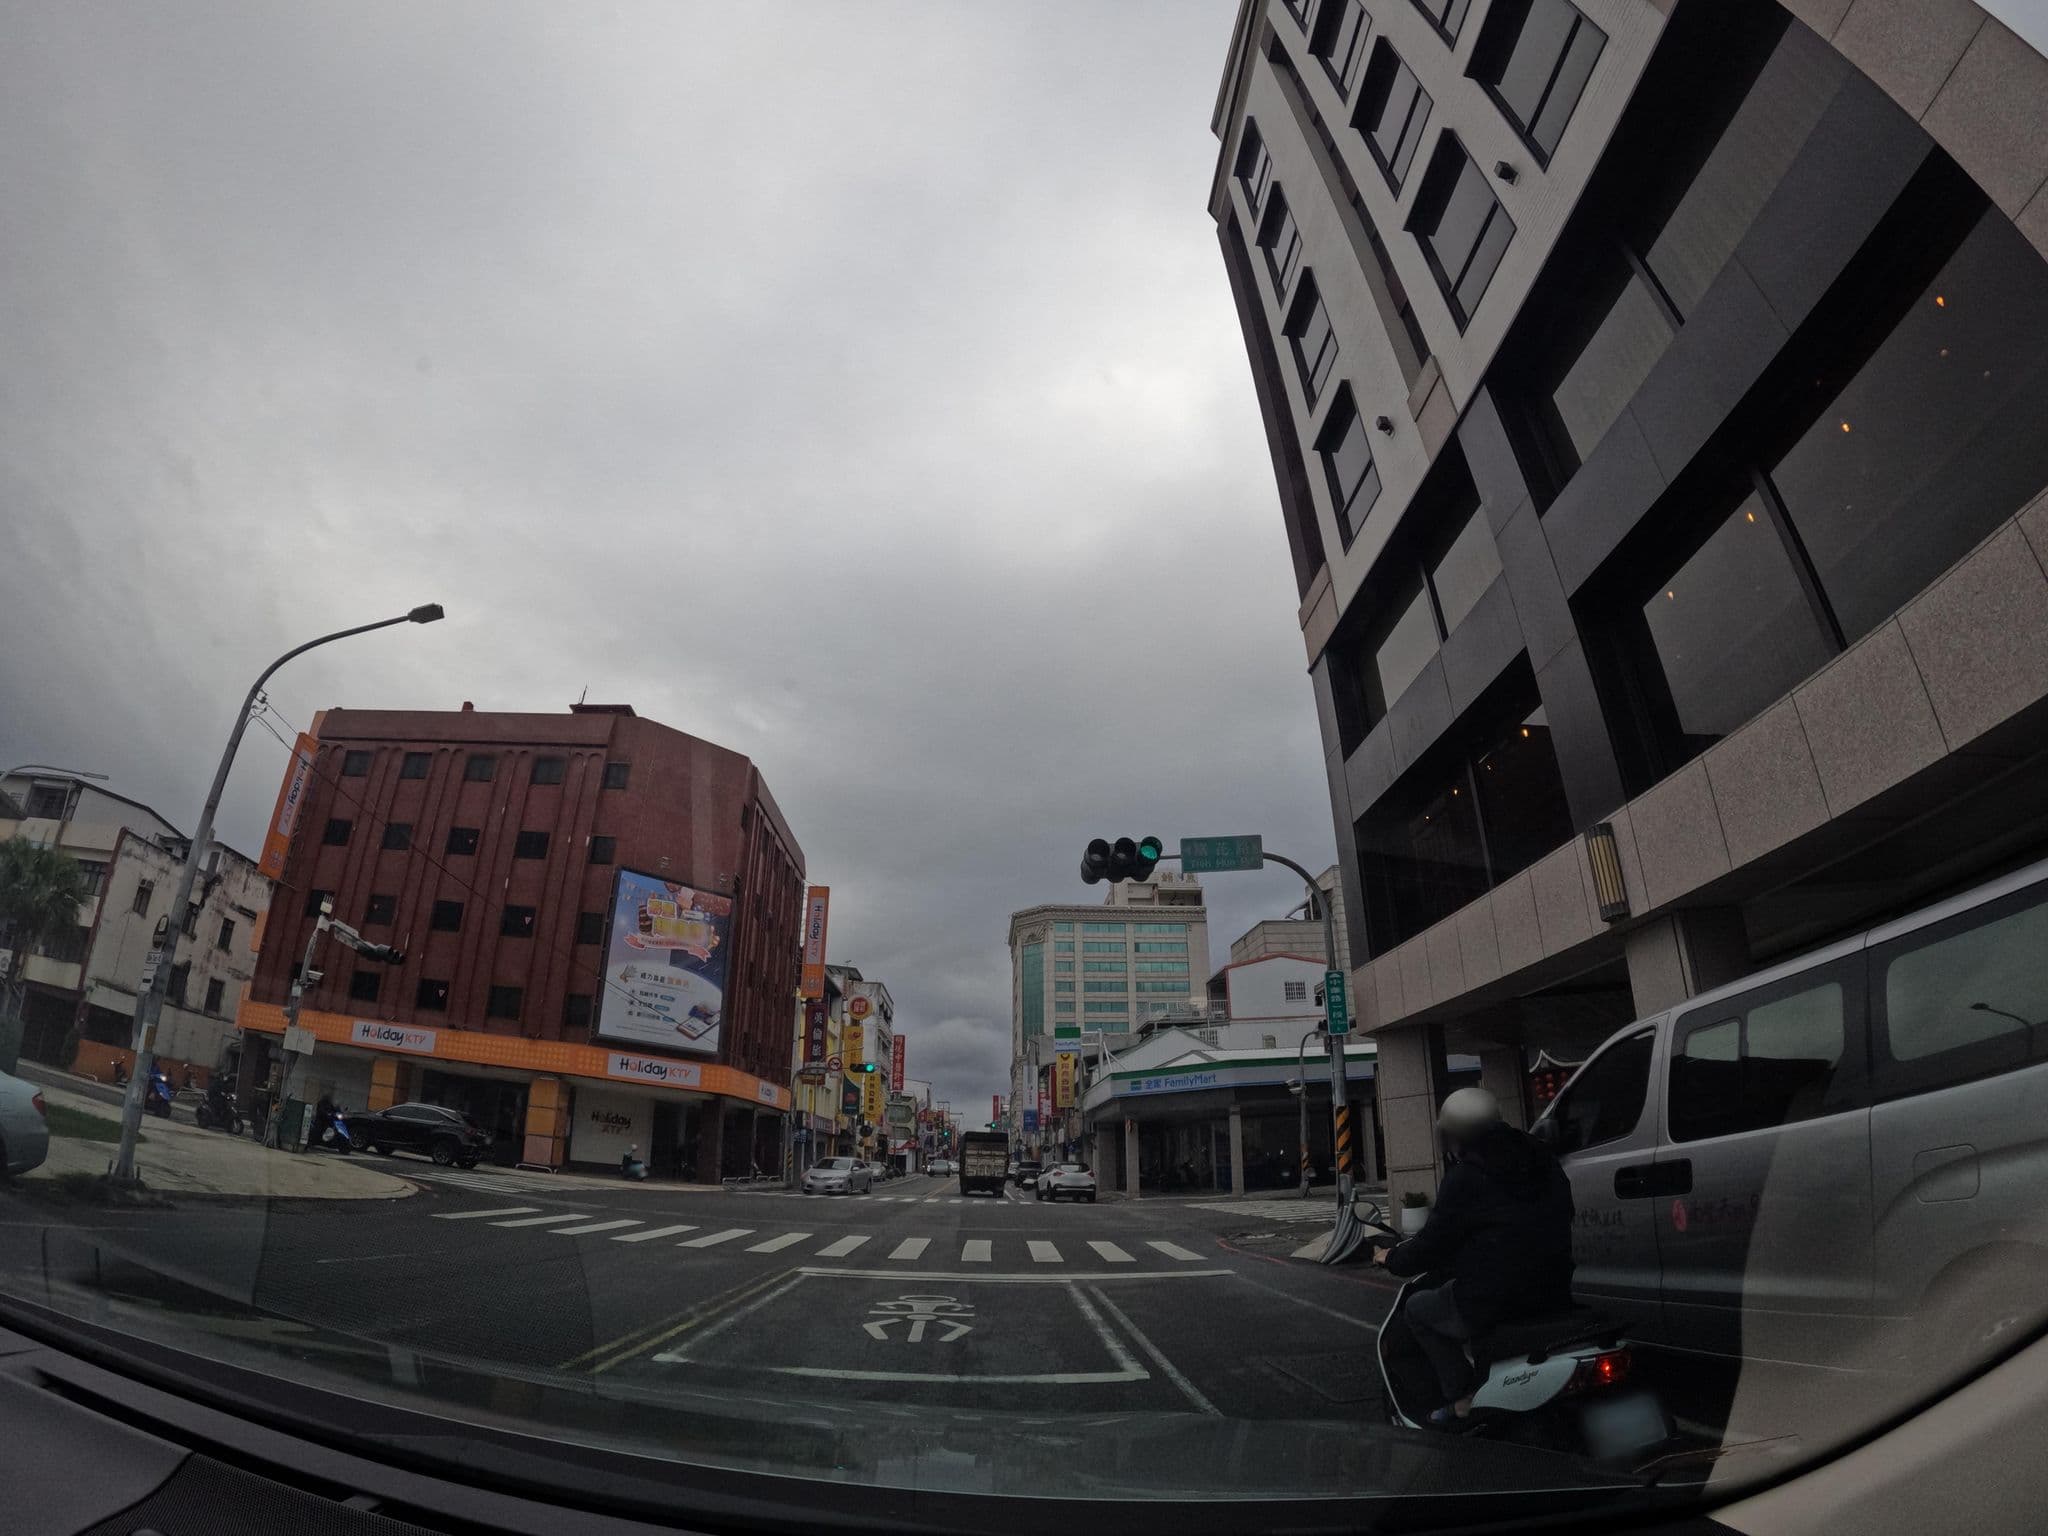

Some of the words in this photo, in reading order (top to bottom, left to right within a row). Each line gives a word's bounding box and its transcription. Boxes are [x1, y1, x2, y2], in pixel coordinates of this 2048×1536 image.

[361, 1023, 404, 1046] Holiday
[619, 1057, 667, 1080] Holiday
[668, 1068, 691, 1079] KTV
[1164, 1073, 1216, 1088] FamilyMart
[592, 1111, 632, 1129] Holiday
